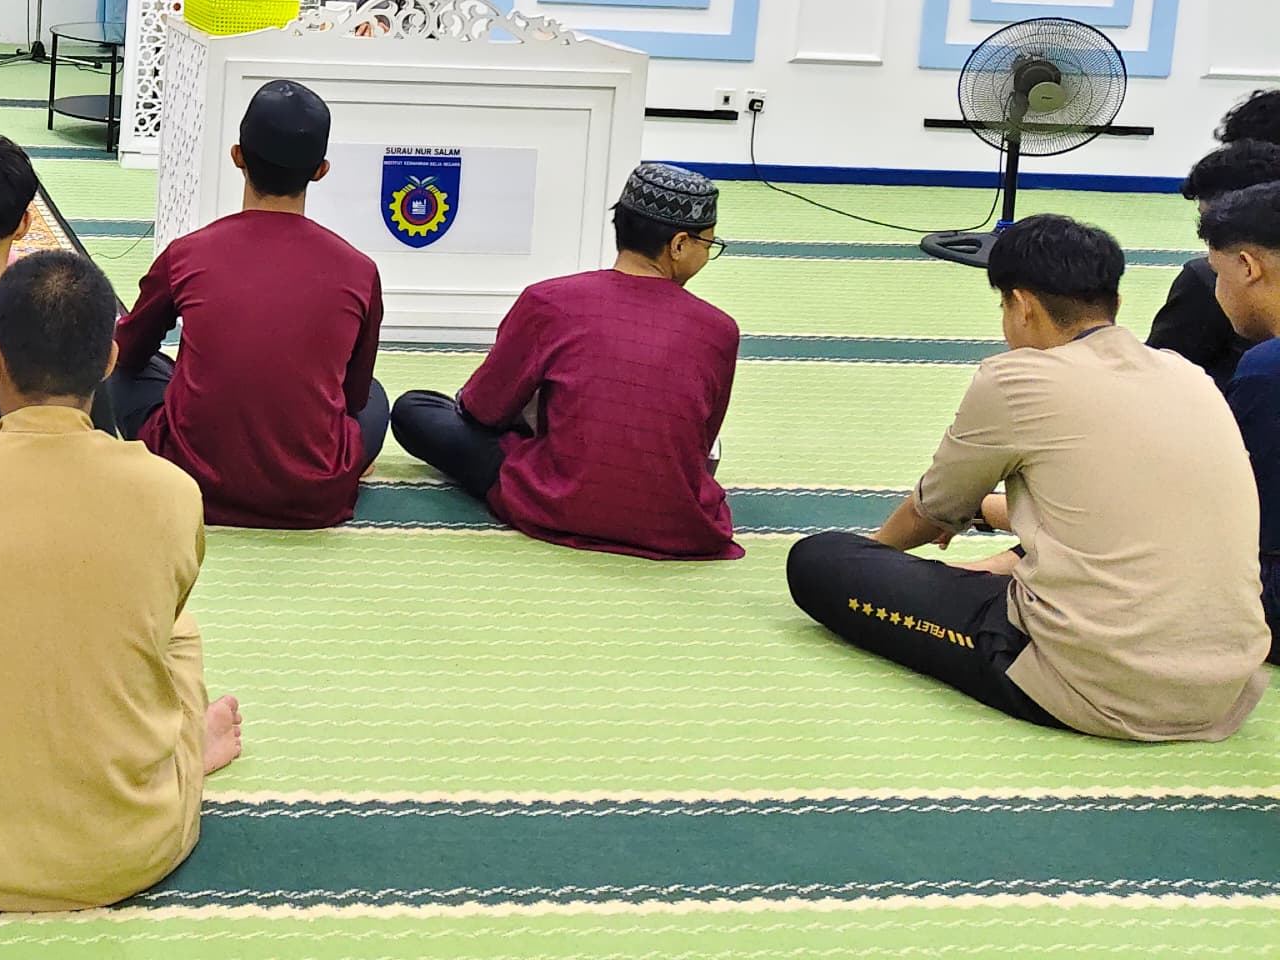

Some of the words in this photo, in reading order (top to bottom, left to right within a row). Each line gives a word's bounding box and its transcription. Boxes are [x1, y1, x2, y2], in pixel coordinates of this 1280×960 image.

[385, 146, 413, 155] SURAU
[415, 147, 432, 155] NUR
[434, 148, 461, 156] SALAM
[915, 619, 946, 639] FELET
